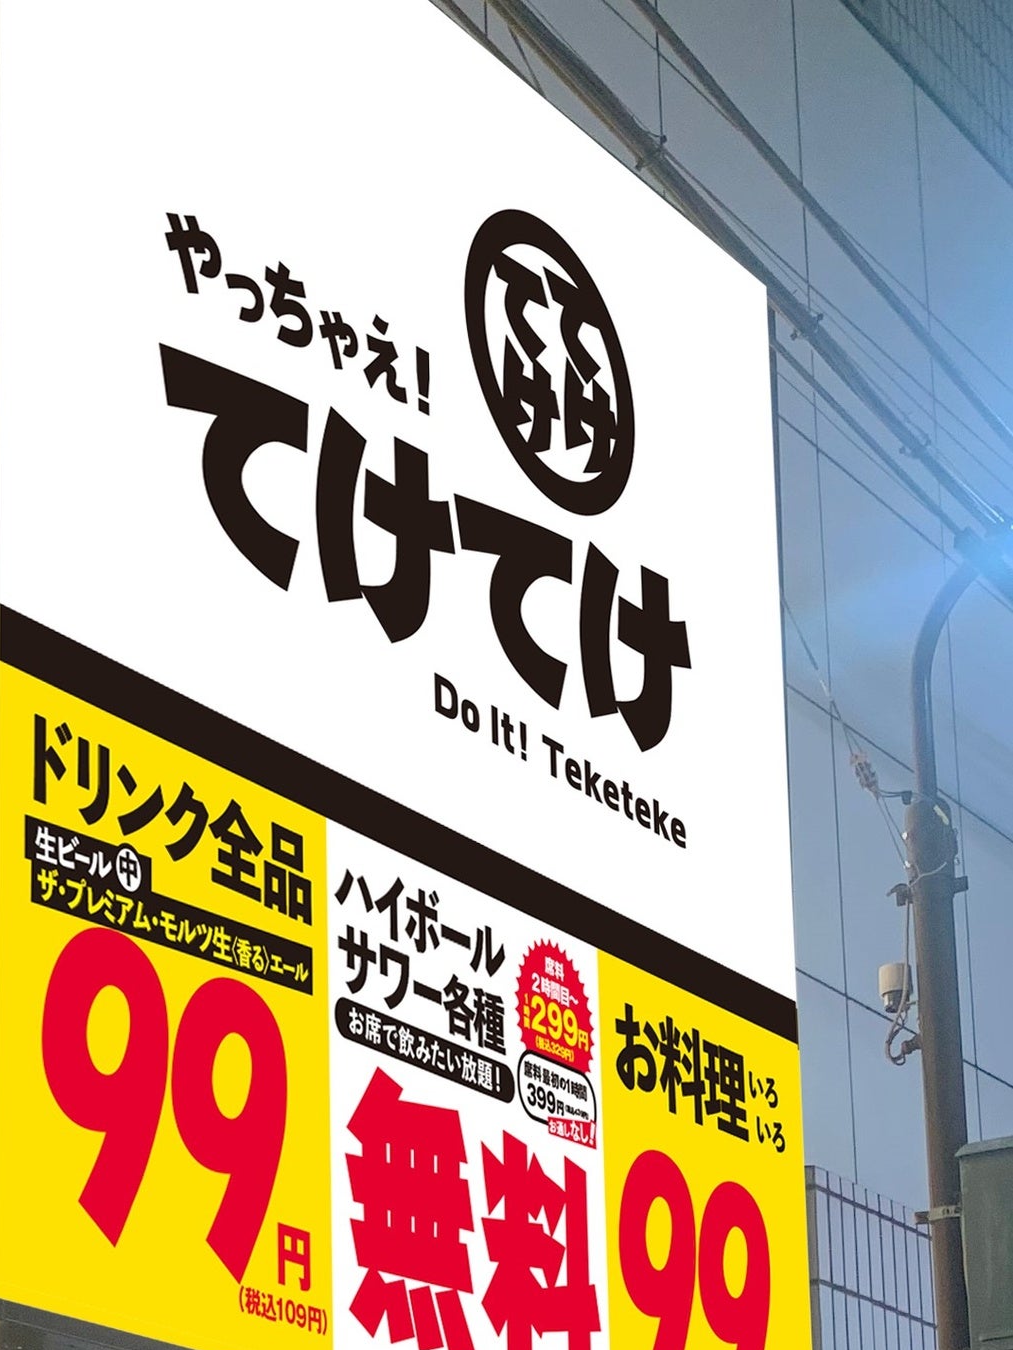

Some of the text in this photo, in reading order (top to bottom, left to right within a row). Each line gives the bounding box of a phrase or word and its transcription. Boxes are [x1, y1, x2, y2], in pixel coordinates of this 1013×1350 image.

[165, 211, 431, 416] やっちゃえ!
[158, 342, 692, 753] てけてけ
[34, 713, 312, 925] ドリンク全品
[433, 672, 688, 849] Do It! Teketeke
[335, 868, 506, 977] ハイボール
[337, 925, 507, 1056] サワー各種
[348, 1006, 502, 1095] お席で飲みたい放題!
[616, 1003, 749, 1143] お料理
[238, 1284, 328, 1335] (税込109円)
